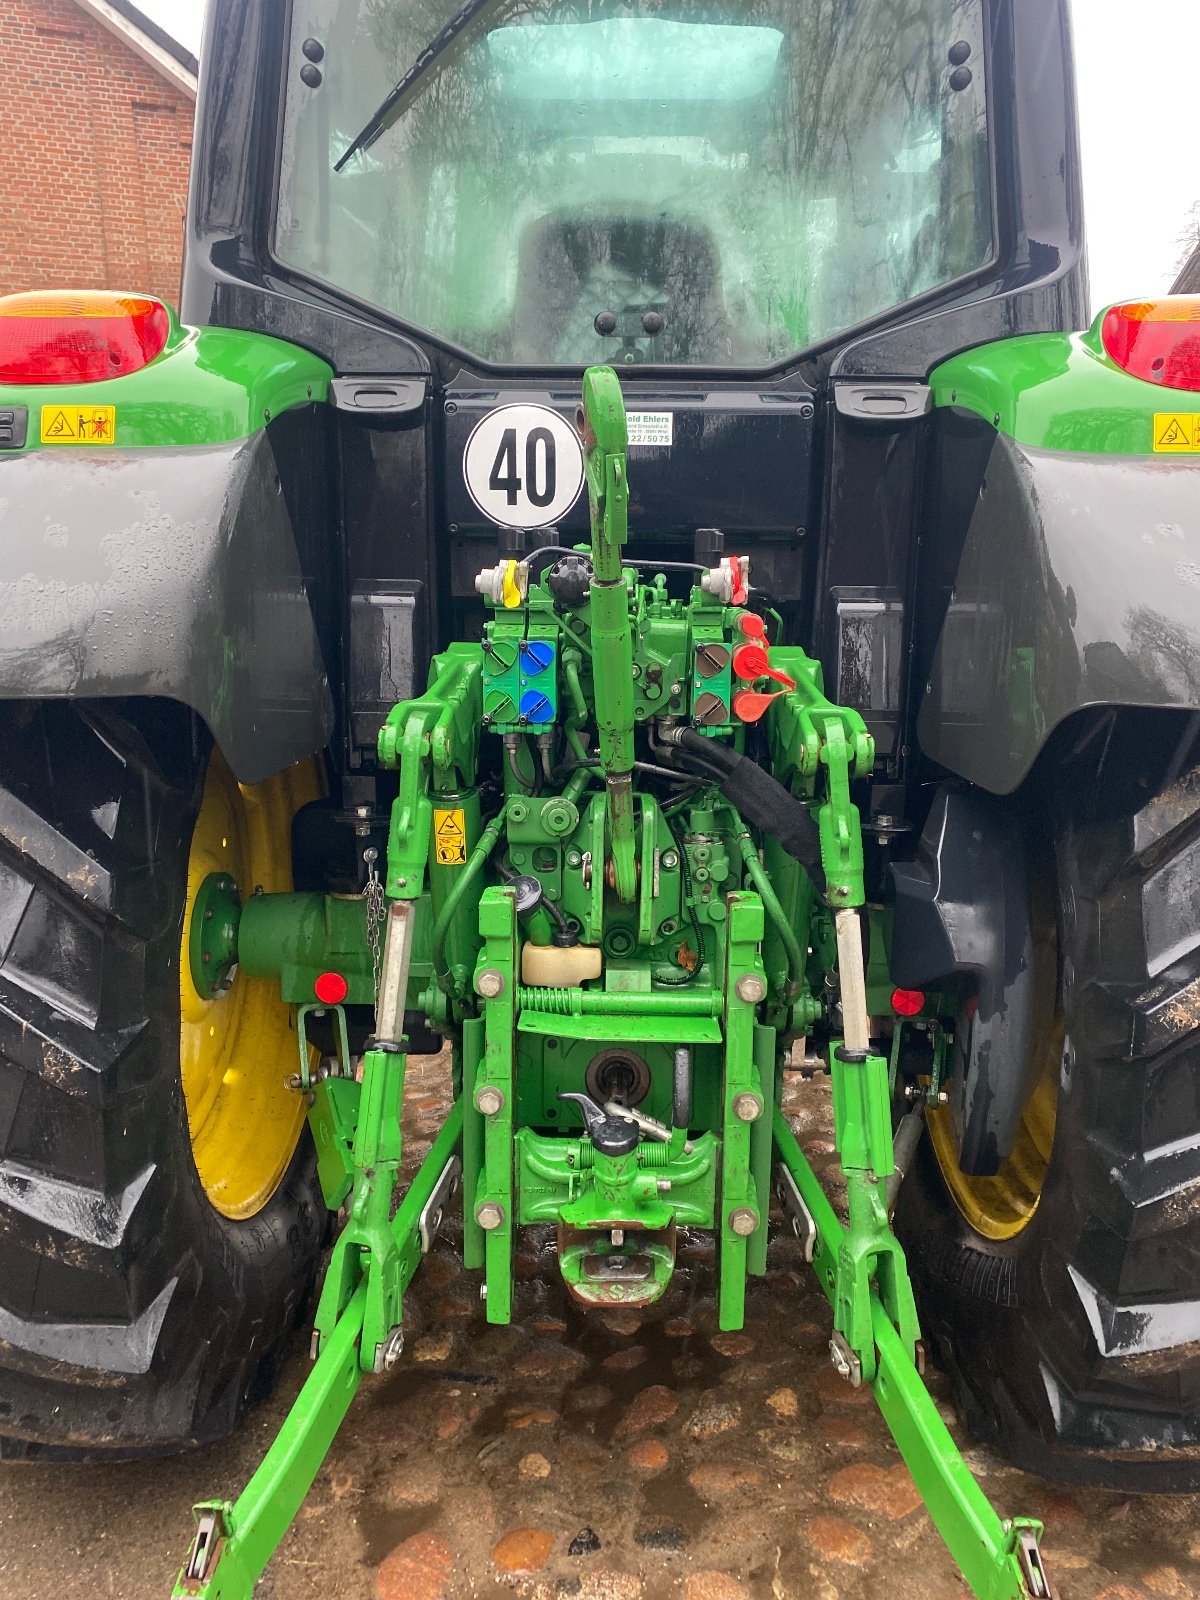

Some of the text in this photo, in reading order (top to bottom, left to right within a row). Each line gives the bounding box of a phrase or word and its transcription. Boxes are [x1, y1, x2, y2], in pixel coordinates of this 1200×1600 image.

[627, 415, 670, 423] old Ehlers
[628, 435, 670, 443] 22/5075
[488, 427, 557, 508] 40
